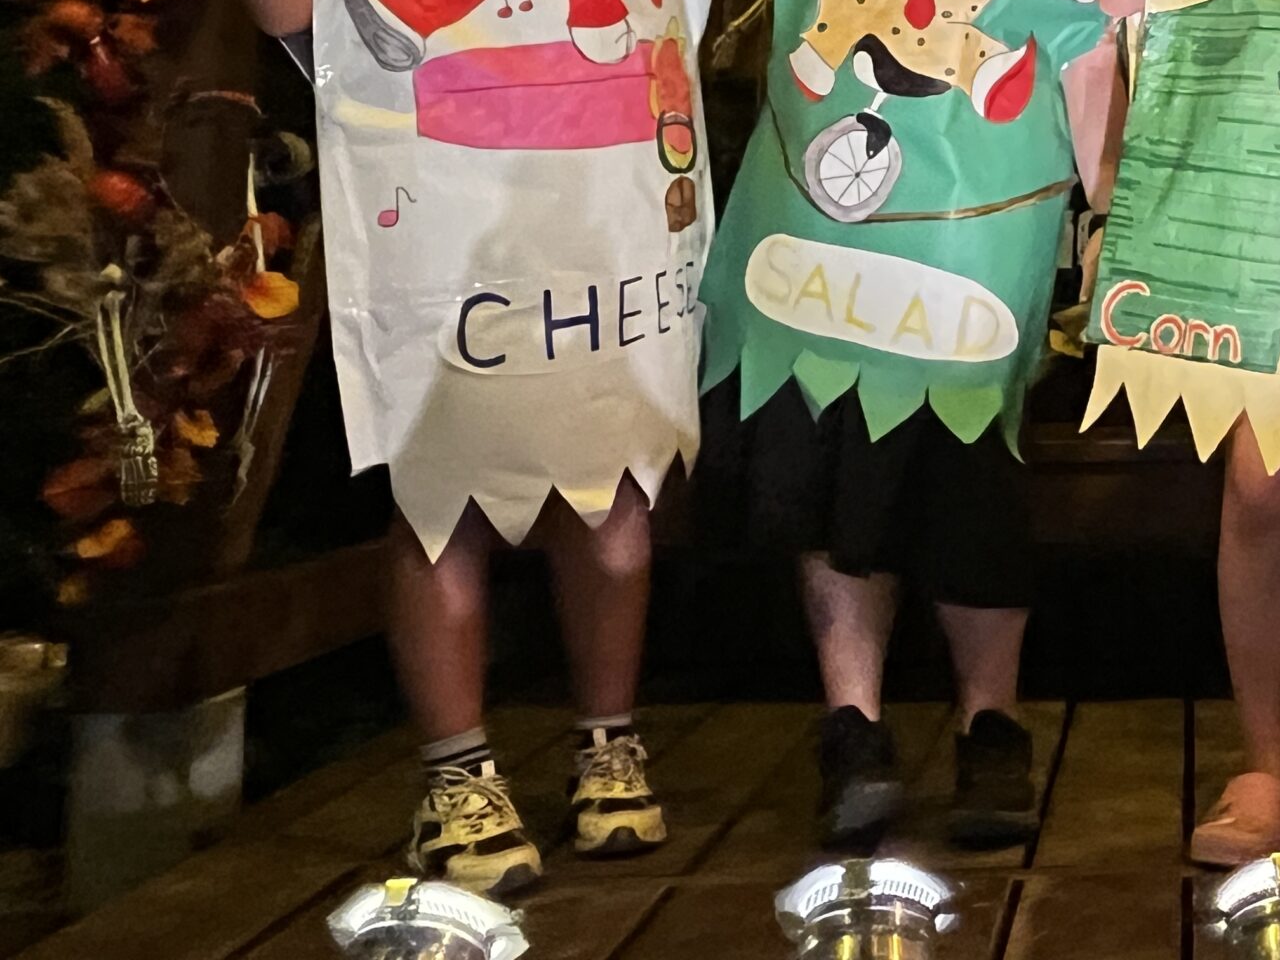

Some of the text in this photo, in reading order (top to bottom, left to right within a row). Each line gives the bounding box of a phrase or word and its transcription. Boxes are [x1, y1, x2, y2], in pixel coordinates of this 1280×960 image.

[456, 260, 698, 369] CHEESE
[753, 239, 1001, 356] SALAD
[1100, 279, 1242, 364] Corn
